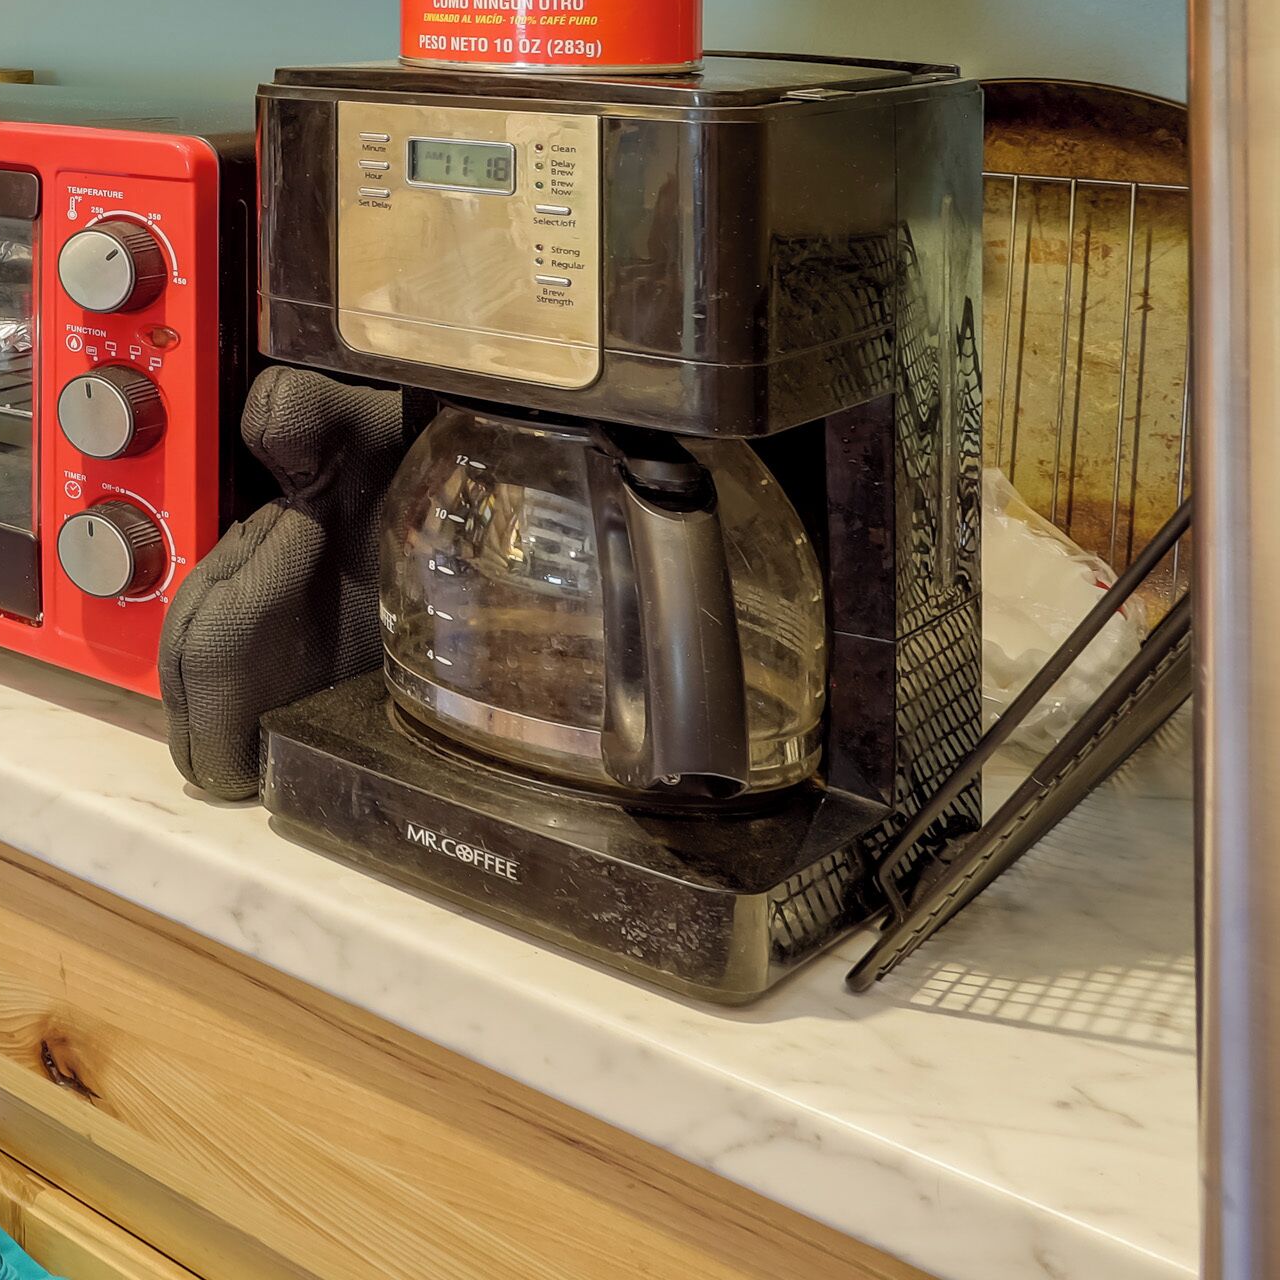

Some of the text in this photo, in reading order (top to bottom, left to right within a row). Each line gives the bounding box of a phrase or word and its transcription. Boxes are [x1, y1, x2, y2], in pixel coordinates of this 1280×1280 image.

[424, 13, 598, 25] ENVASADO AL 100% CAFÉ PURO
[419, 34, 602, 57] PESO NETO 10 OZ (283g)
[362, 144, 386, 152] Minute
[550, 160, 576, 170] Delay
[364, 172, 382, 180] Hour
[550, 168, 574, 176] Brew
[550, 180, 574, 188] Brew
[68, 186, 123, 199] TEMPERATURE
[550, 188, 572, 196] Now
[372, 201, 392, 210] Delay
[533, 218, 576, 228] Select/off
[550, 247, 580, 257] Strong
[551, 260, 584, 270] Regular
[173, 277, 187, 285] 450
[542, 289, 565, 297] Brew
[536, 296, 574, 306] Strength
[66, 325, 106, 337] FUNCTION
[456, 455, 469, 465] 12
[64, 471, 86, 481] TIMER
[435, 508, 447, 519] 10
[429, 560, 435, 570] 8
[427, 605, 433, 615] 6
[427, 649, 434, 659] 4
